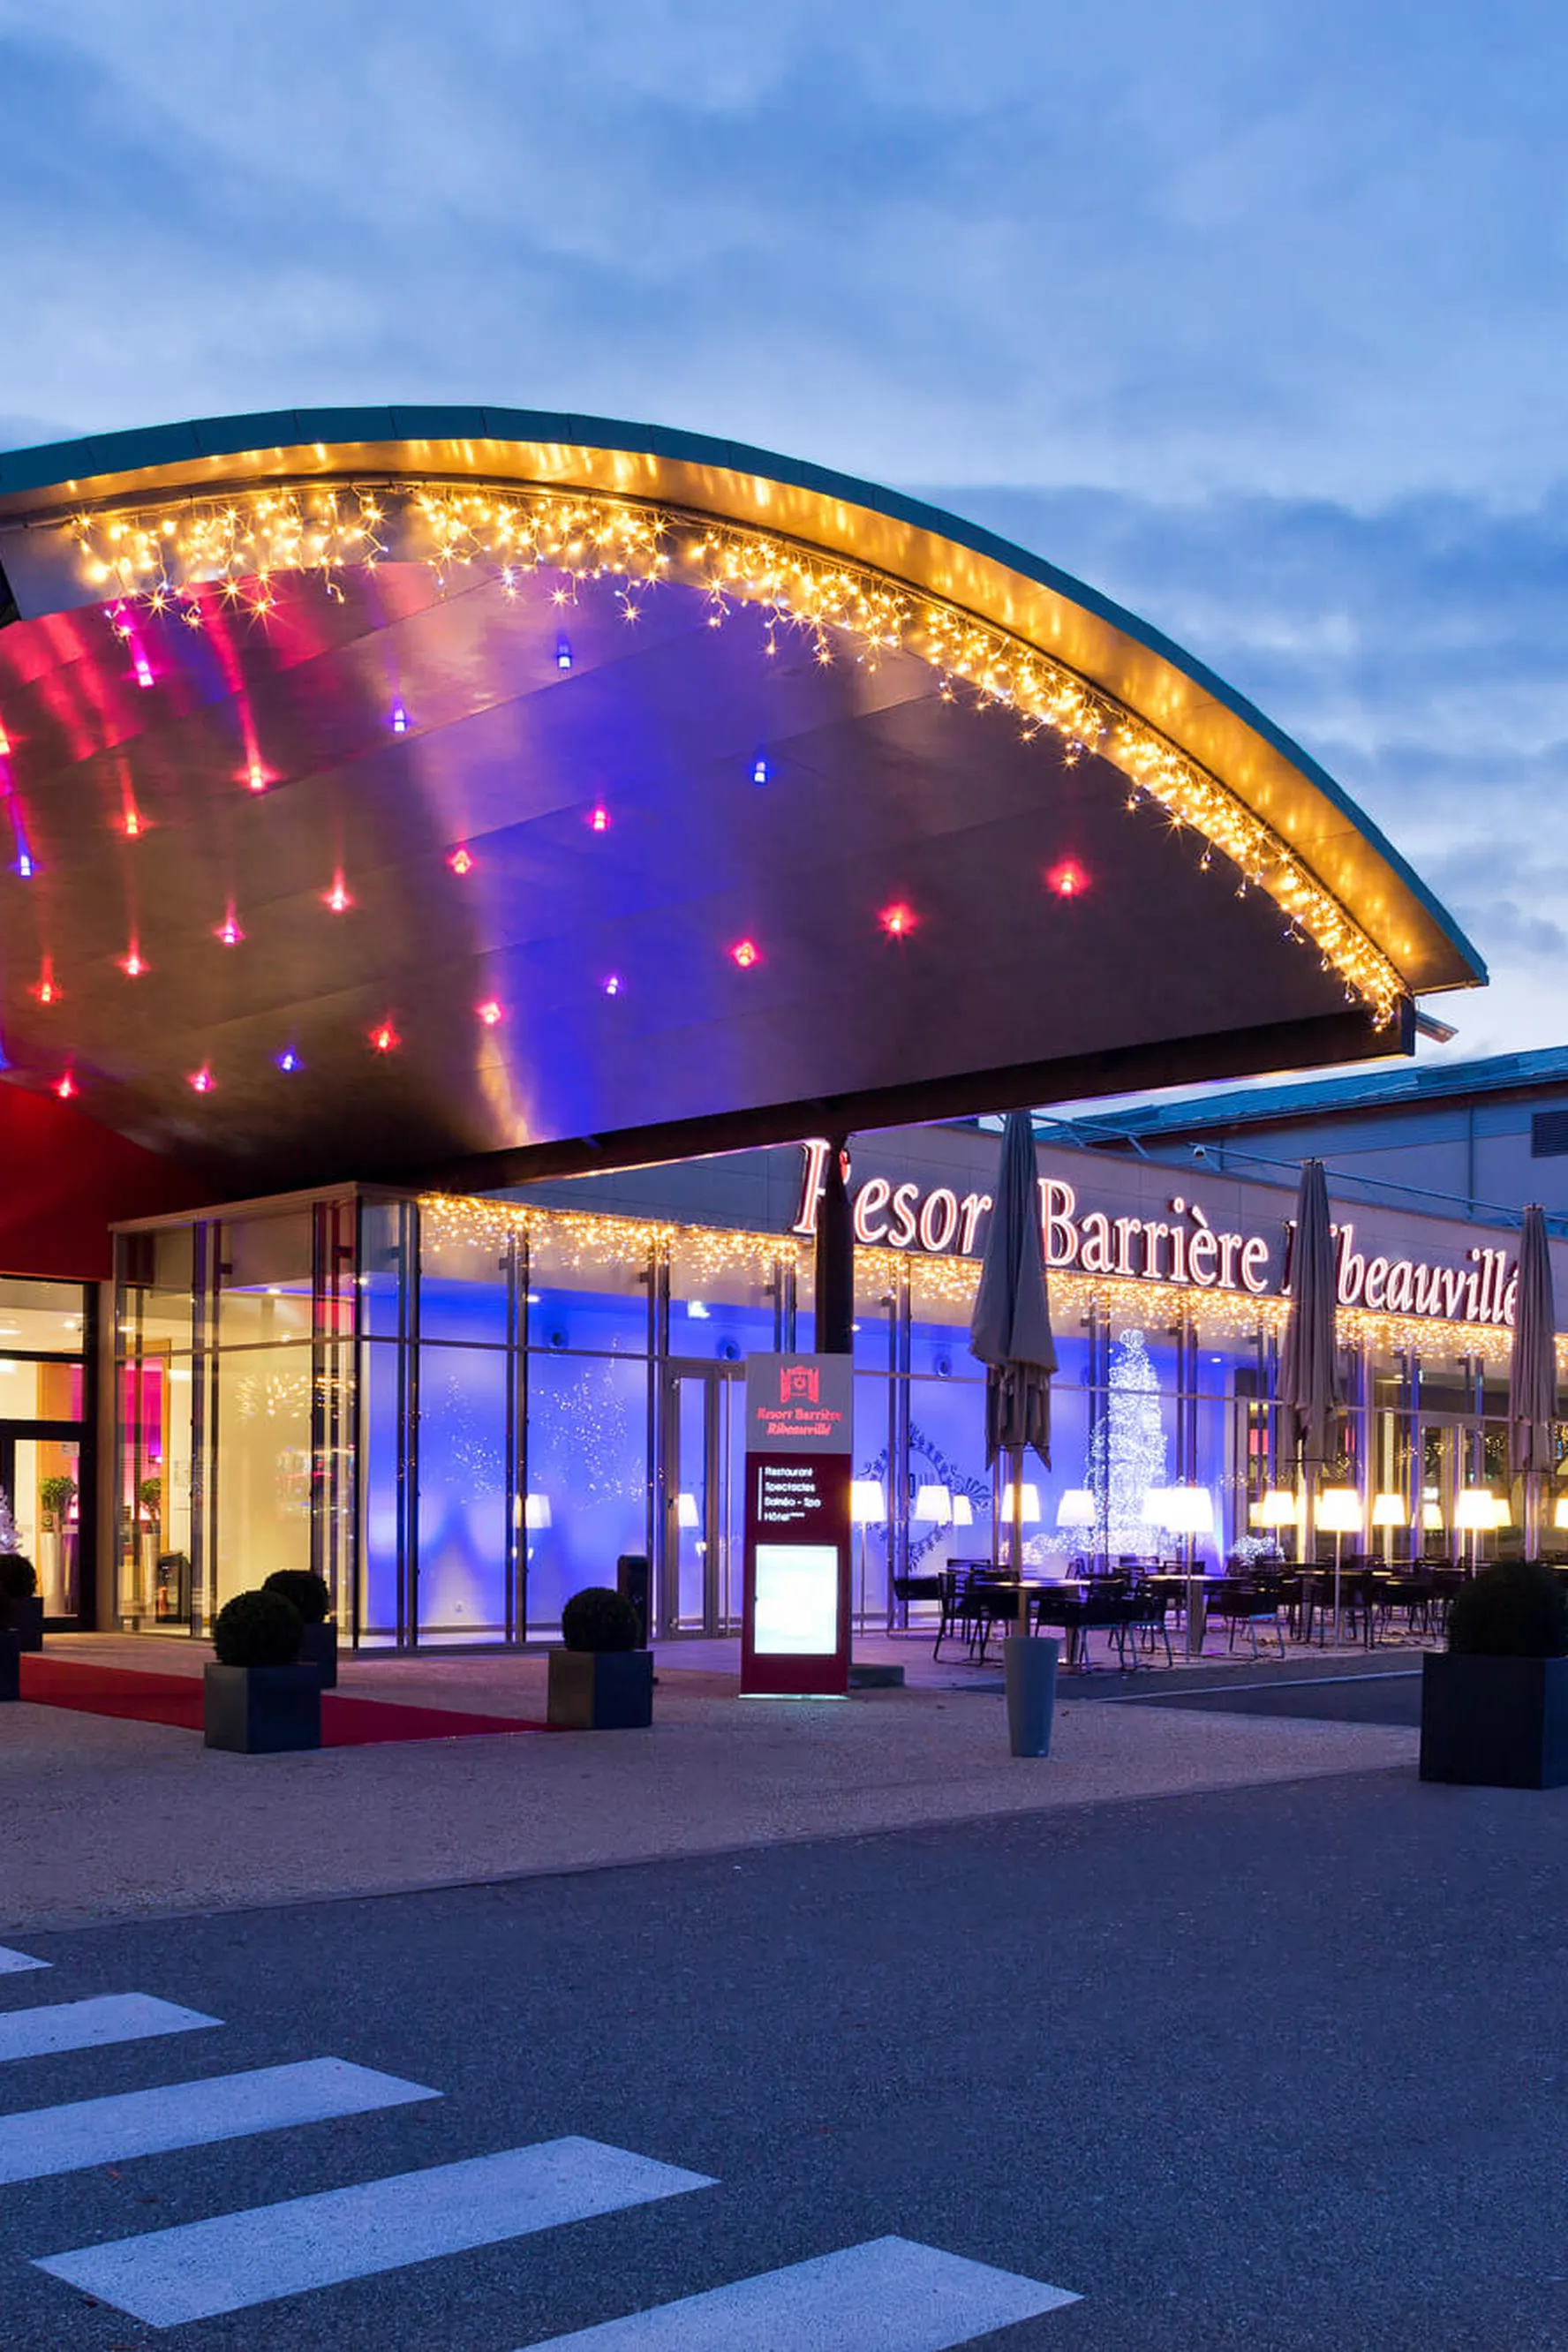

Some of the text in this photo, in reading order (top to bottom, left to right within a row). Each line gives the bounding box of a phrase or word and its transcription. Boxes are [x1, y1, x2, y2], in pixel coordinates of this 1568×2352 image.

[793, 1138, 1518, 1324] esor Barrière beauvillé
